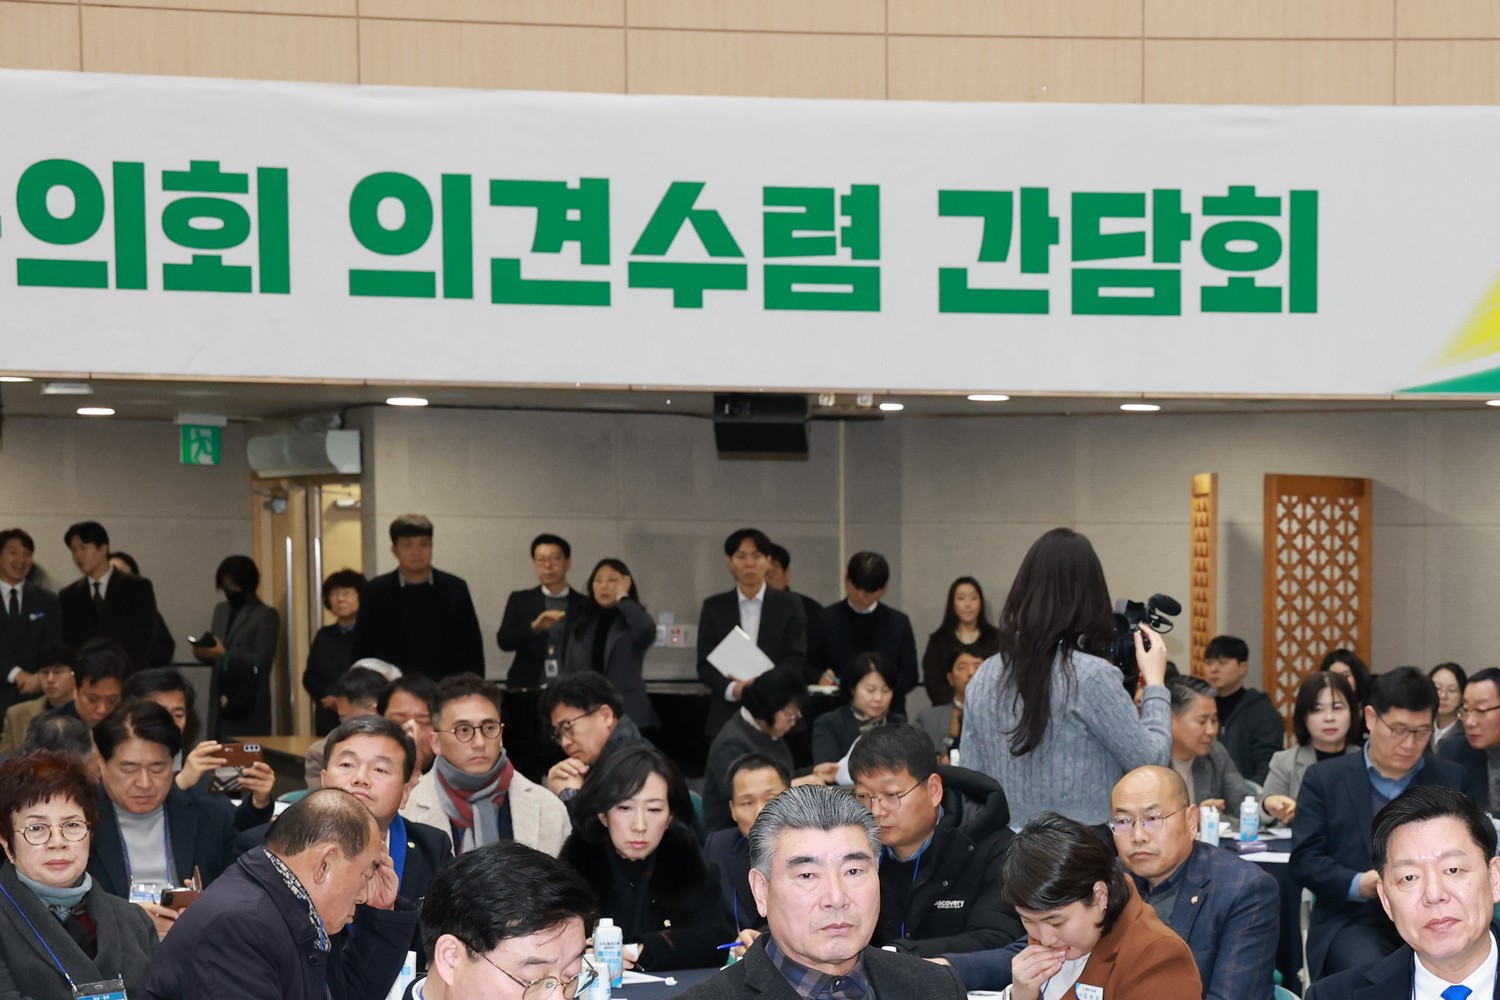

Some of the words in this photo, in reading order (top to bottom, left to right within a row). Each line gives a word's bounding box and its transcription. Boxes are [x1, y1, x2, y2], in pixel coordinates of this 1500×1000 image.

[0, 158, 290, 294] 의회
[349, 171, 881, 312] 의견수렴
[938, 185, 1319, 316] 간담회
